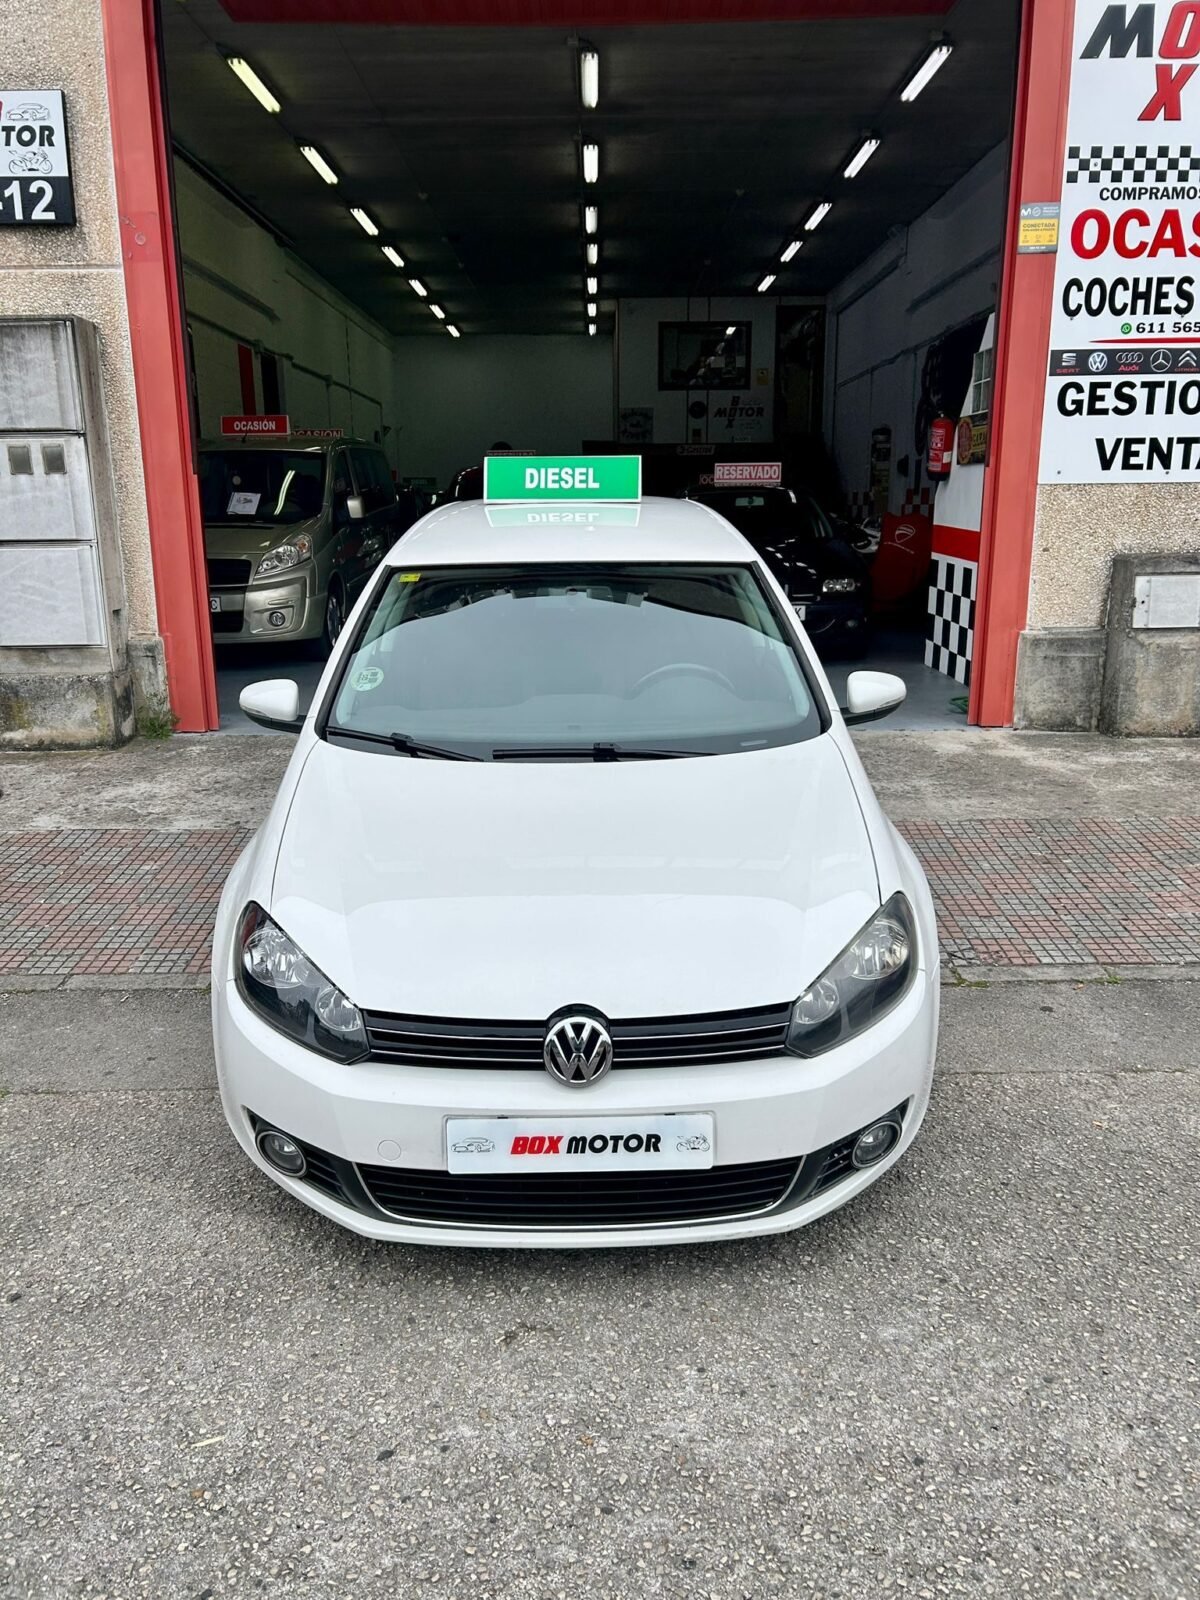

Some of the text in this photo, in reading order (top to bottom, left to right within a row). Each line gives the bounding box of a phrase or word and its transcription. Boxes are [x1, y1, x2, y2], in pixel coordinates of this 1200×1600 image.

[0, 180, 56, 220] 12
[1100, 186, 1200, 200] COMPRAMO
[1062, 275, 1195, 318] COCHES
[1136, 322, 1165, 333] 611
[233, 420, 276, 431] OCASIÓN
[1095, 436, 1200, 471] VENT
[524, 467, 600, 489] DIESEL
[716, 466, 779, 479] RESERVADO
[511, 1133, 662, 1154] BOX MOTOR
